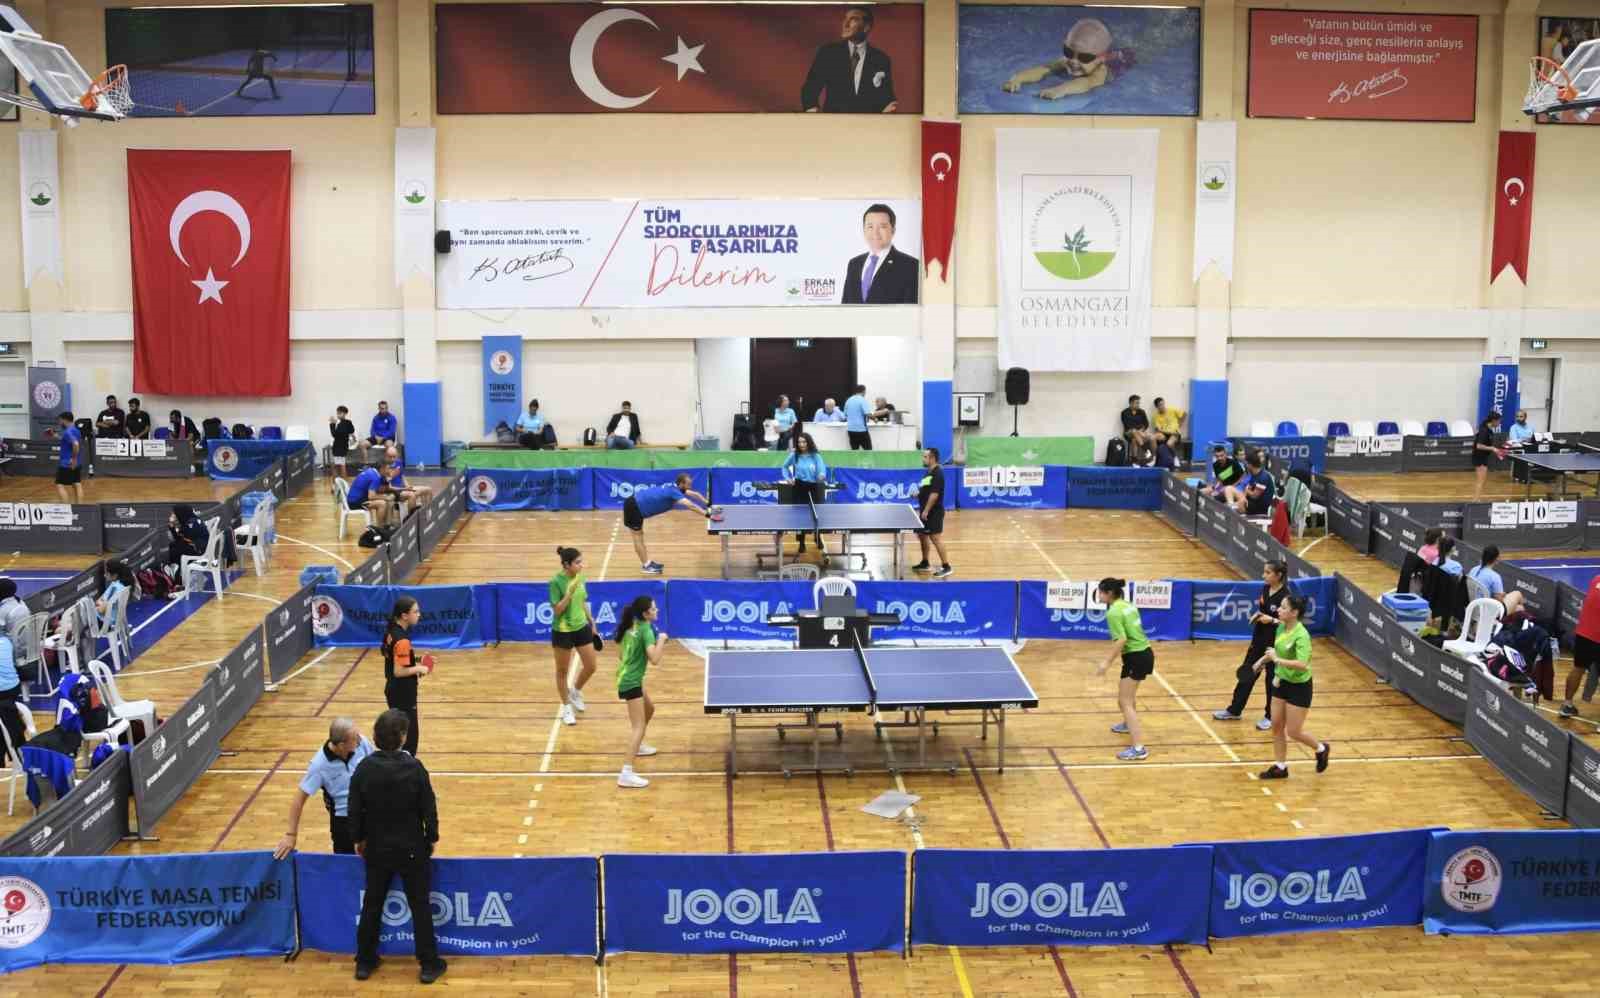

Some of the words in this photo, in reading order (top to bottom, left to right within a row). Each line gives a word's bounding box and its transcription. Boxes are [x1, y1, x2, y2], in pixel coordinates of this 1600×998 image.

[1420, 24, 1433, 32] ve
[1375, 37, 1424, 48] nesillerin
[1296, 51, 1309, 60] ve
[1311, 49, 1364, 62] enerjisine
[644, 207, 681, 223] TÜM
[643, 225, 798, 239] SPORCULARIMIZA
[690, 239, 798, 255] BAŞARILAR
[1007, 471, 1017, 483] 2
[856, 482, 920, 499] JOOLA
[1523, 507, 1530, 520] 1
[1536, 505, 1547, 519] 0
[701, 599, 789, 623] JOOLA
[876, 600, 966, 624] JOOLA
[829, 634, 839, 648] 4
[1511, 856, 1590, 877] TÜRKİYE
[56, 885, 145, 909] TÜRKİYE
[151, 887, 214, 905] MASA
[218, 879, 282, 901] TENİSİ
[1224, 866, 1367, 910] JOOLA
[1459, 891, 1481, 902] TMTF
[663, 887, 822, 925] JOOLA
[970, 881, 1127, 918] JOOLA
[96, 911, 247, 929] FEDERASYONU
[1239, 914, 1257, 925] for
[1260, 911, 1280, 921] the
[1282, 910, 1344, 924] Champion
[1347, 912, 1360, 921] in
[1362, 904, 1389, 921] you!
[988, 923, 1007, 934] for
[1010, 922, 1031, 932] the
[1035, 923, 1102, 938] Champion
[1106, 929, 1119, 937] in
[1122, 921, 1152, 938] you!
[495, 940, 508, 949] in
[511, 933, 541, 950] you!
[682, 930, 701, 942] for
[704, 929, 726, 939] the
[730, 929, 799, 948] Champion
[803, 937, 816, 946] in
[818, 929, 848, 946] you!
